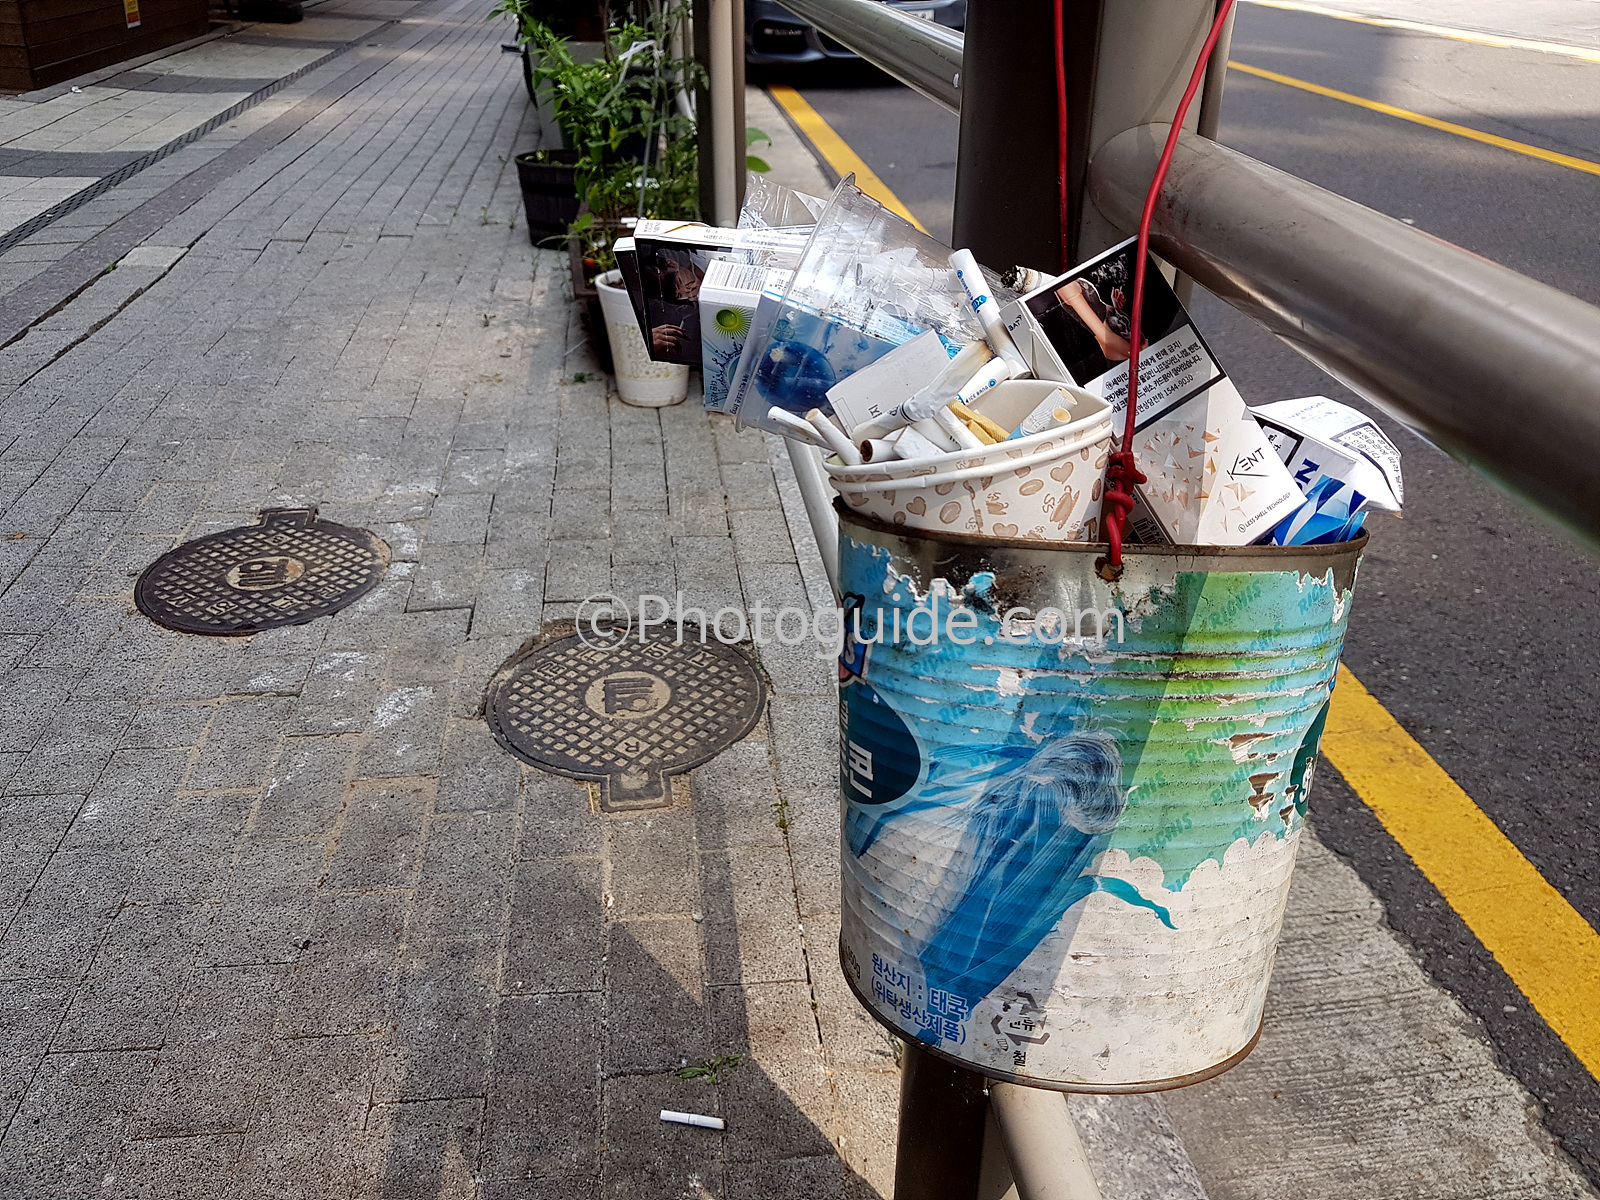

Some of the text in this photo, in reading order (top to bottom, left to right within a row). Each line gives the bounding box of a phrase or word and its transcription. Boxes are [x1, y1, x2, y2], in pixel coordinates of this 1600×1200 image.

[1163, 374, 1195, 397] 1544-9030
[1226, 447, 1270, 481] KENT
[872, 953, 911, 995] 원산지
[929, 987, 969, 1020] 태국
[870, 976, 967, 1045] (위탁생산제품)
[1013, 1050, 1027, 1067] 철
